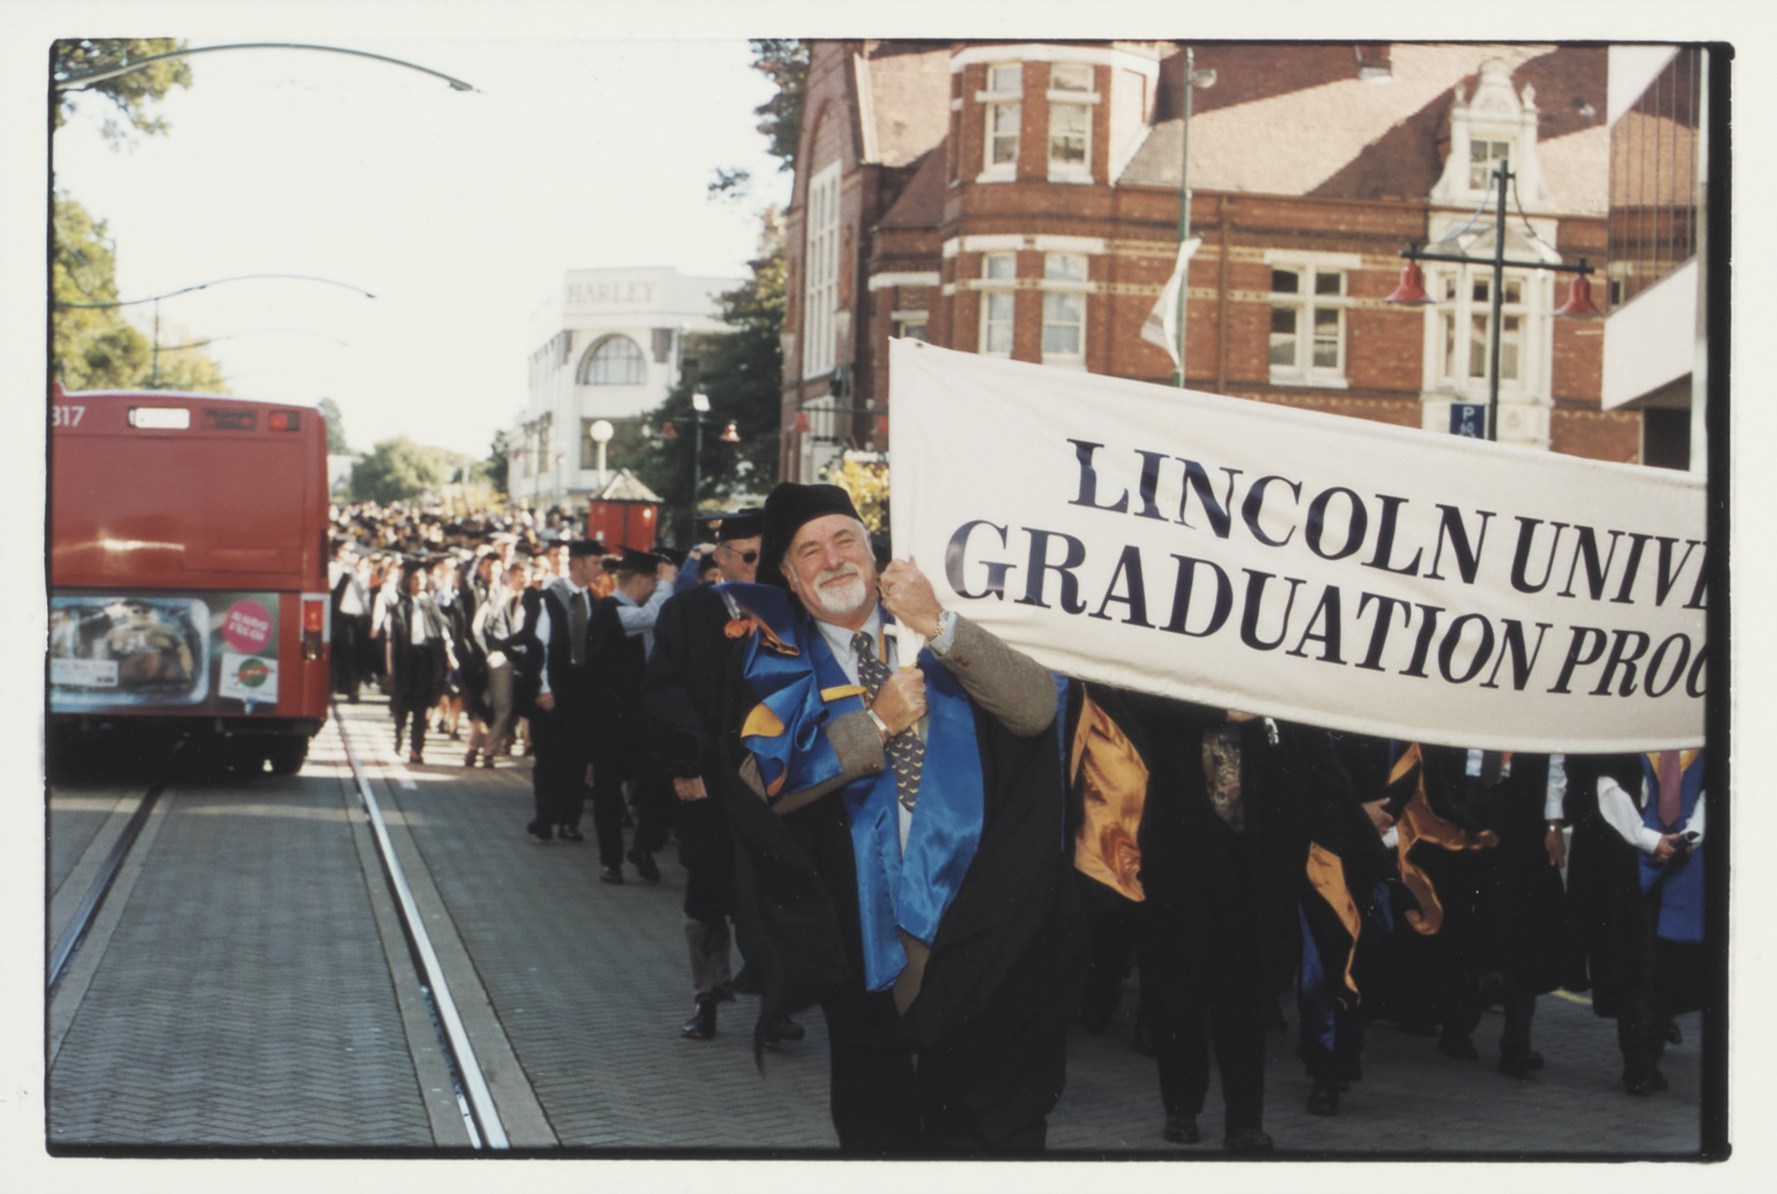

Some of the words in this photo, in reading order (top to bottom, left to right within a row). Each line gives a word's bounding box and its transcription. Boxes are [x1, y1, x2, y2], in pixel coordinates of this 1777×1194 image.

[567, 282, 656, 303] HARLEY
[1463, 406, 1475, 420] P
[1066, 438, 1497, 585] LINCOLN
[945, 519, 1553, 691] GRADUATION
